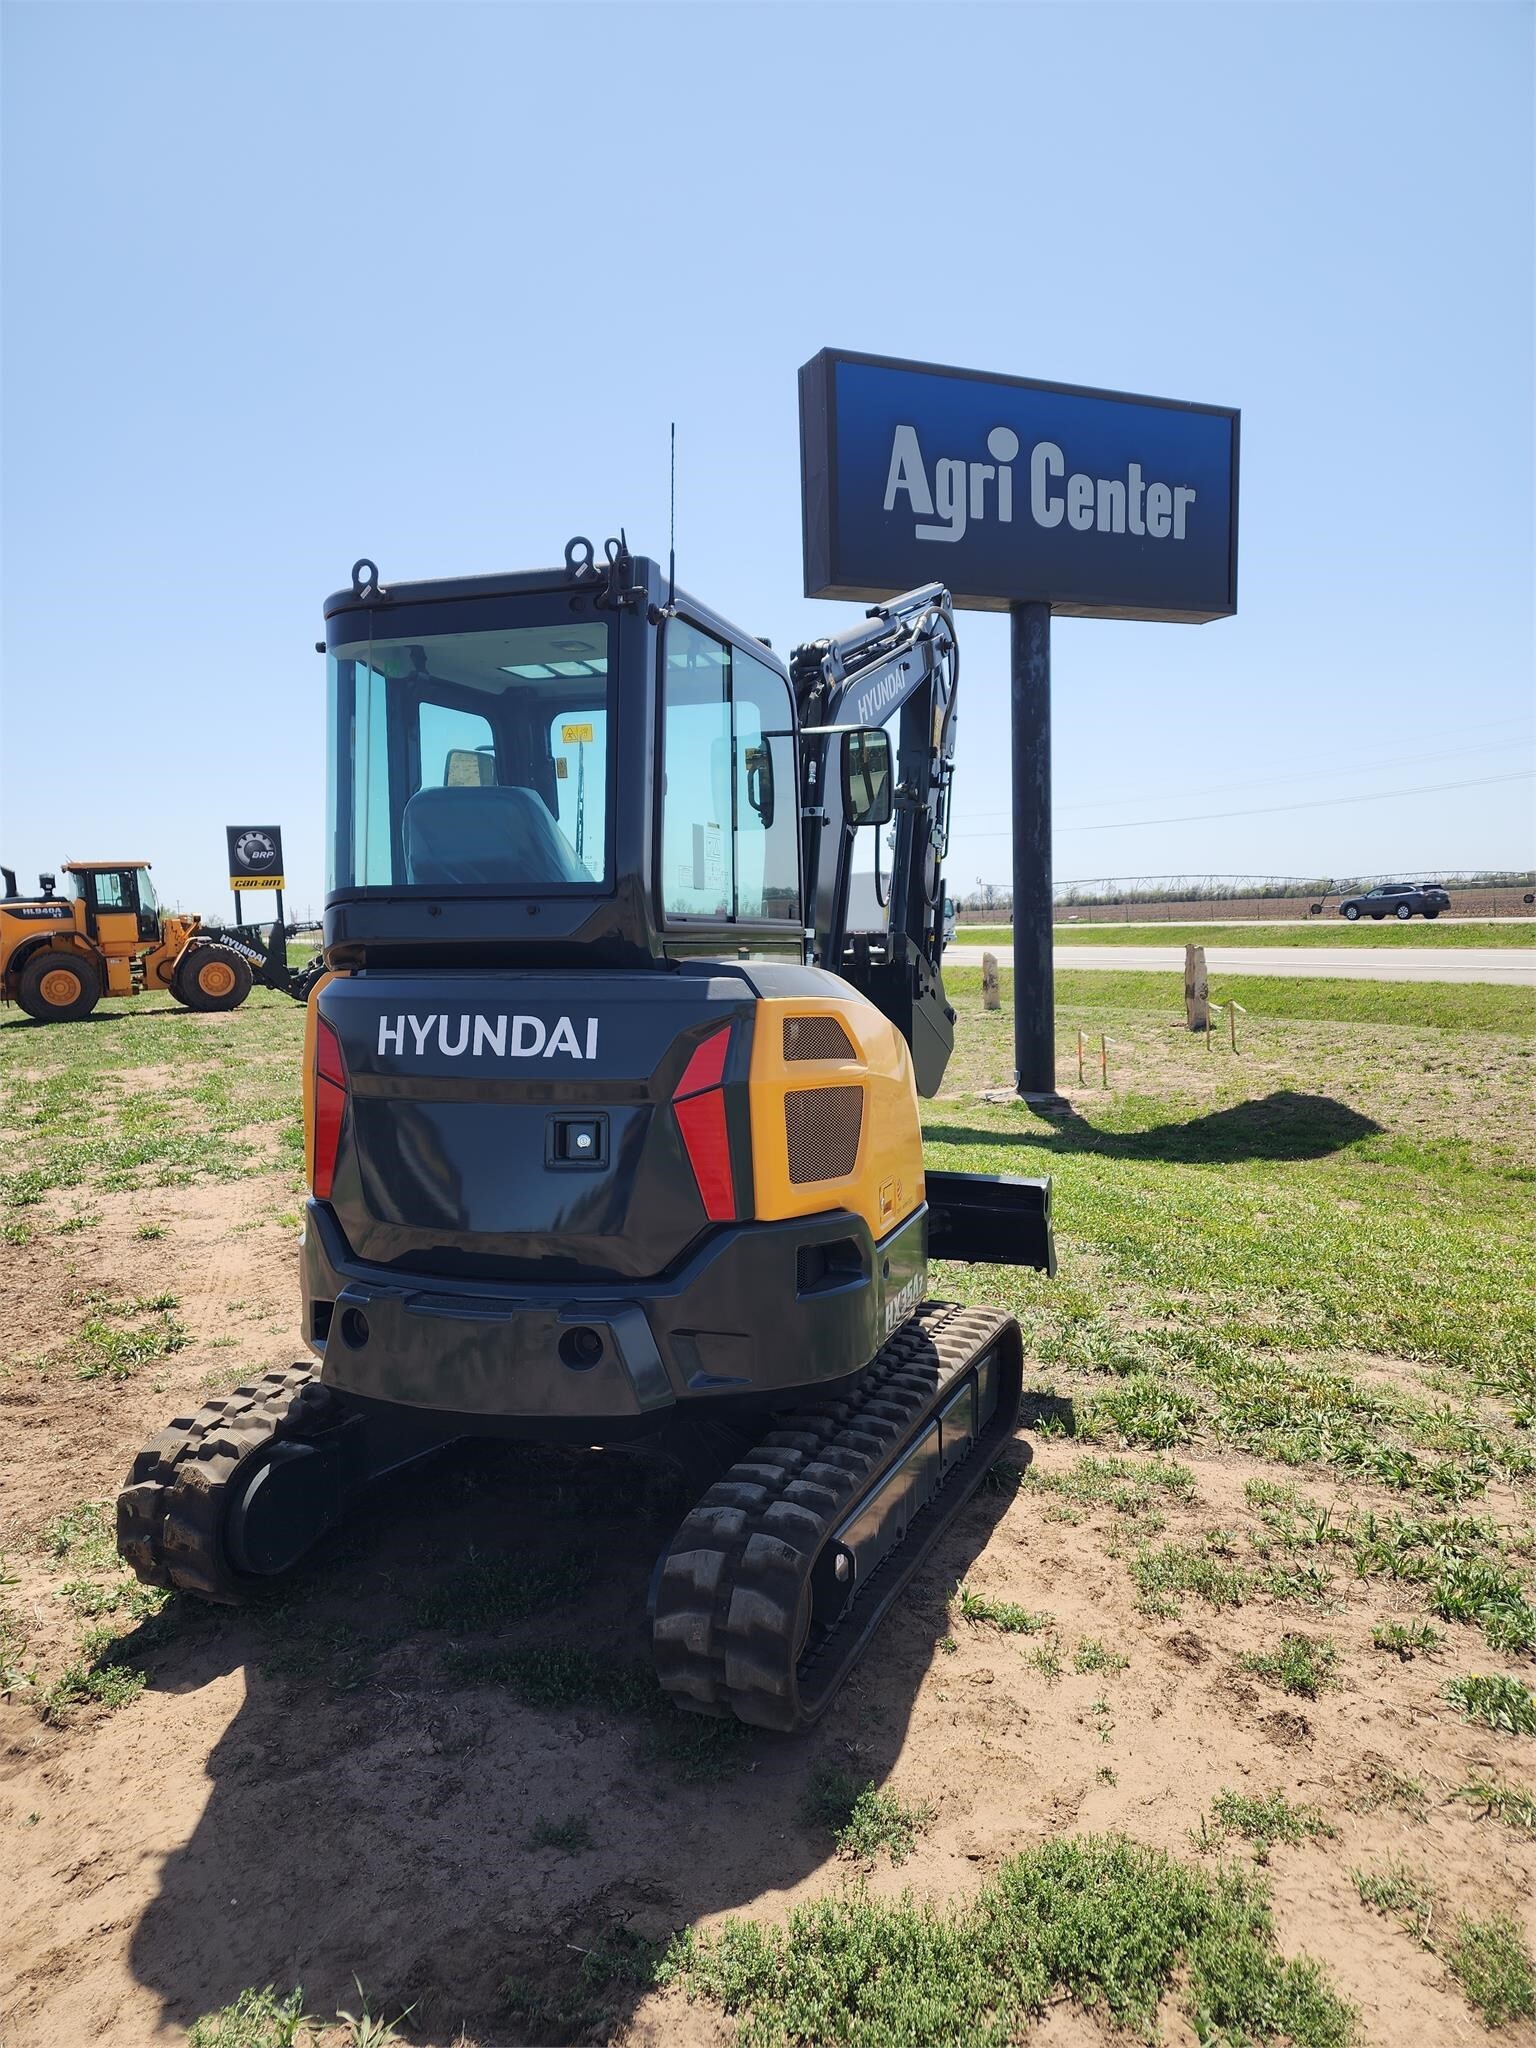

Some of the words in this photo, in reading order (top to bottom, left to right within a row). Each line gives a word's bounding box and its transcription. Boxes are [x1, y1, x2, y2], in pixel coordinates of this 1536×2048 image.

[883, 424, 1019, 542] Agri
[1030, 441, 1196, 540] Center
[858, 664, 906, 725] HYUNDAI
[252, 851, 274, 859] BRP
[220, 934, 267, 964] HYUNDAI
[377, 1014, 599, 1060] HYUNDAI
